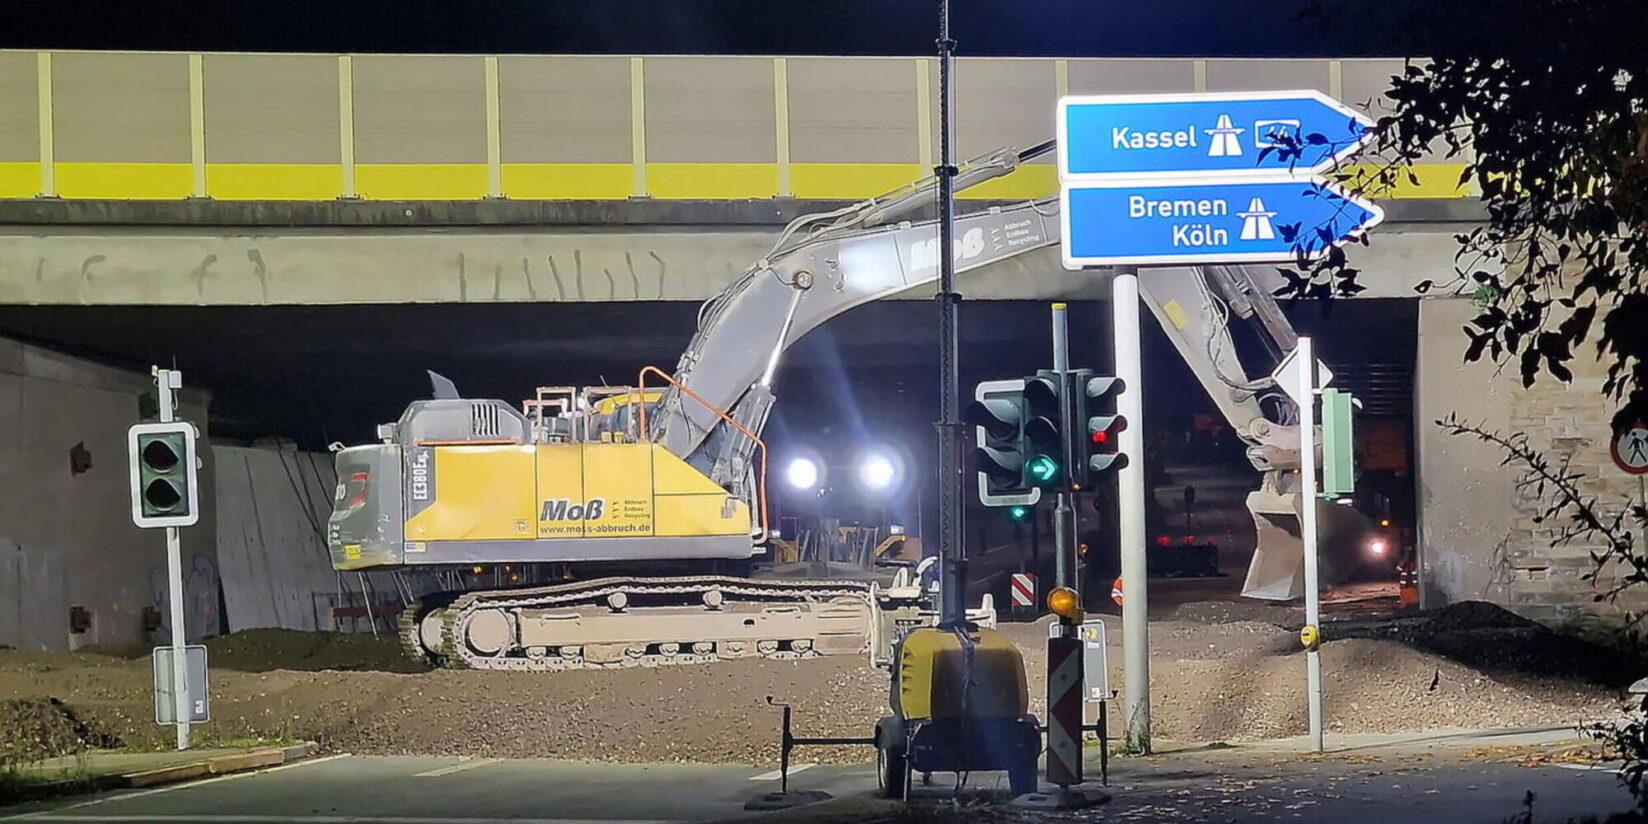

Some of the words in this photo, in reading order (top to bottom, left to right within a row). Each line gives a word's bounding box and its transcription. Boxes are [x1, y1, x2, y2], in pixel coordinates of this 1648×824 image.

[1112, 126, 1197, 149] Kassel
[1128, 196, 1227, 217] Bremen
[1172, 224, 1228, 246] Köln
[540, 499, 603, 521] Moß
